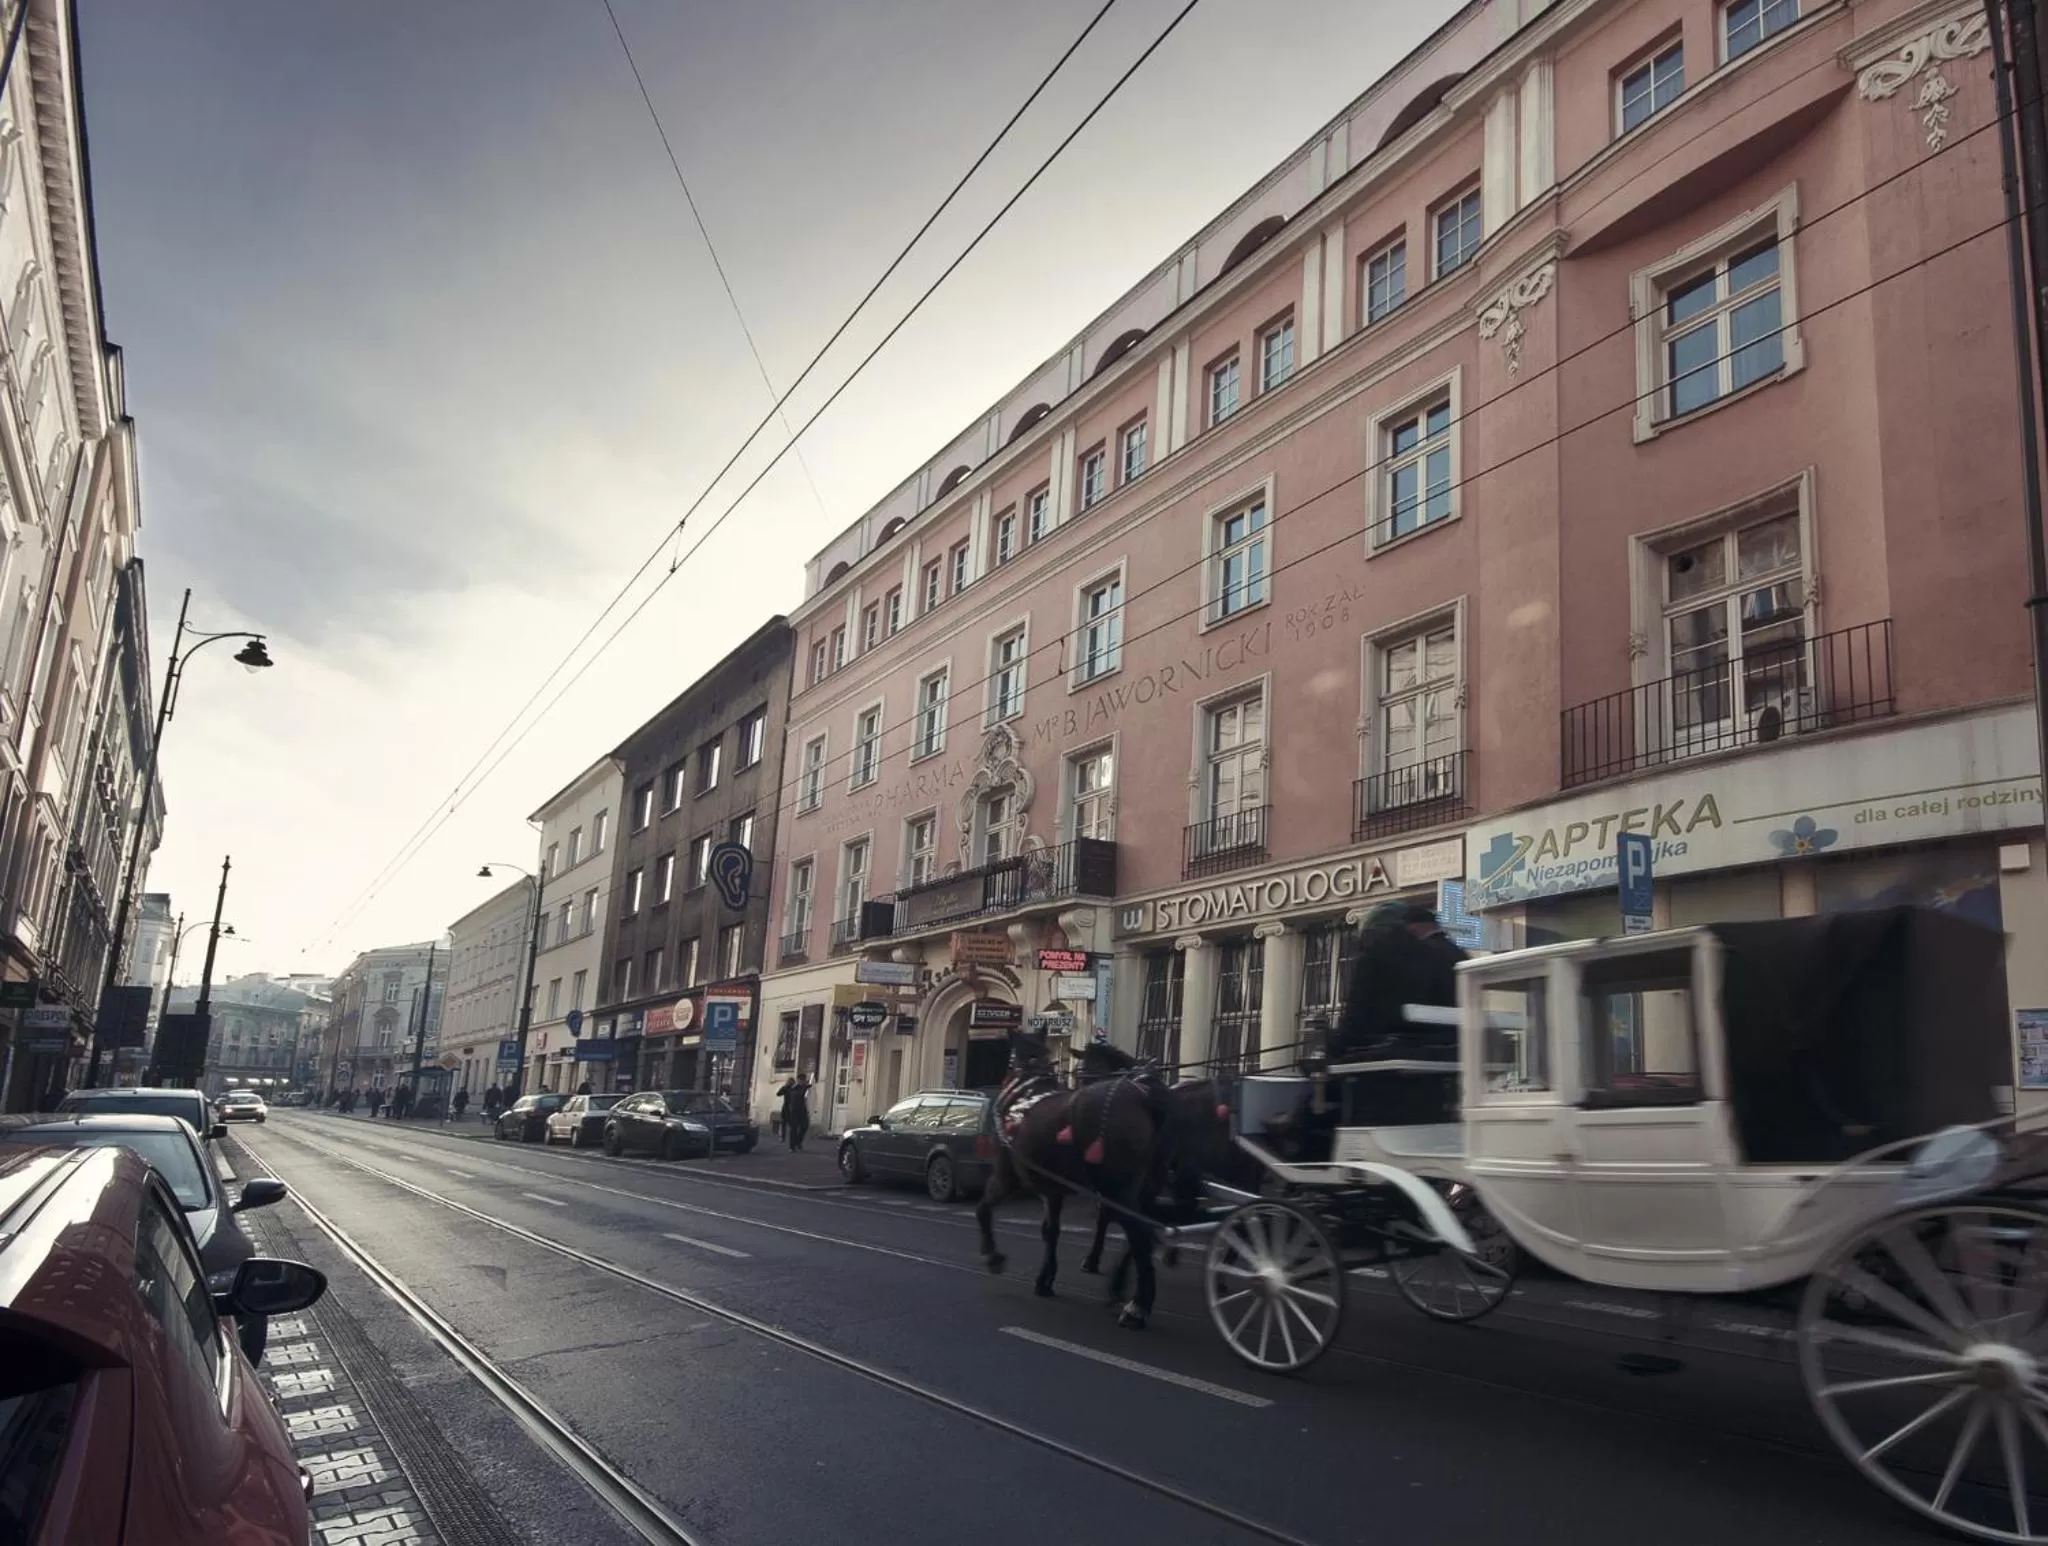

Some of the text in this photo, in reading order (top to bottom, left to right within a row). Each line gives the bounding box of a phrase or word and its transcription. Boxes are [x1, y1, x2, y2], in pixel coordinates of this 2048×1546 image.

[1083, 621, 1273, 734] JAWORNICKI
[1532, 793, 1722, 865] APTEKA
[1853, 808, 1888, 825] dla
[1893, 797, 1950, 820] całej
[1526, 840, 1689, 885] Niezapomjka
[1627, 841, 1647, 890] P
[1158, 858, 1391, 930] STOMATOLOGIA
[713, 1005, 732, 1028] P
